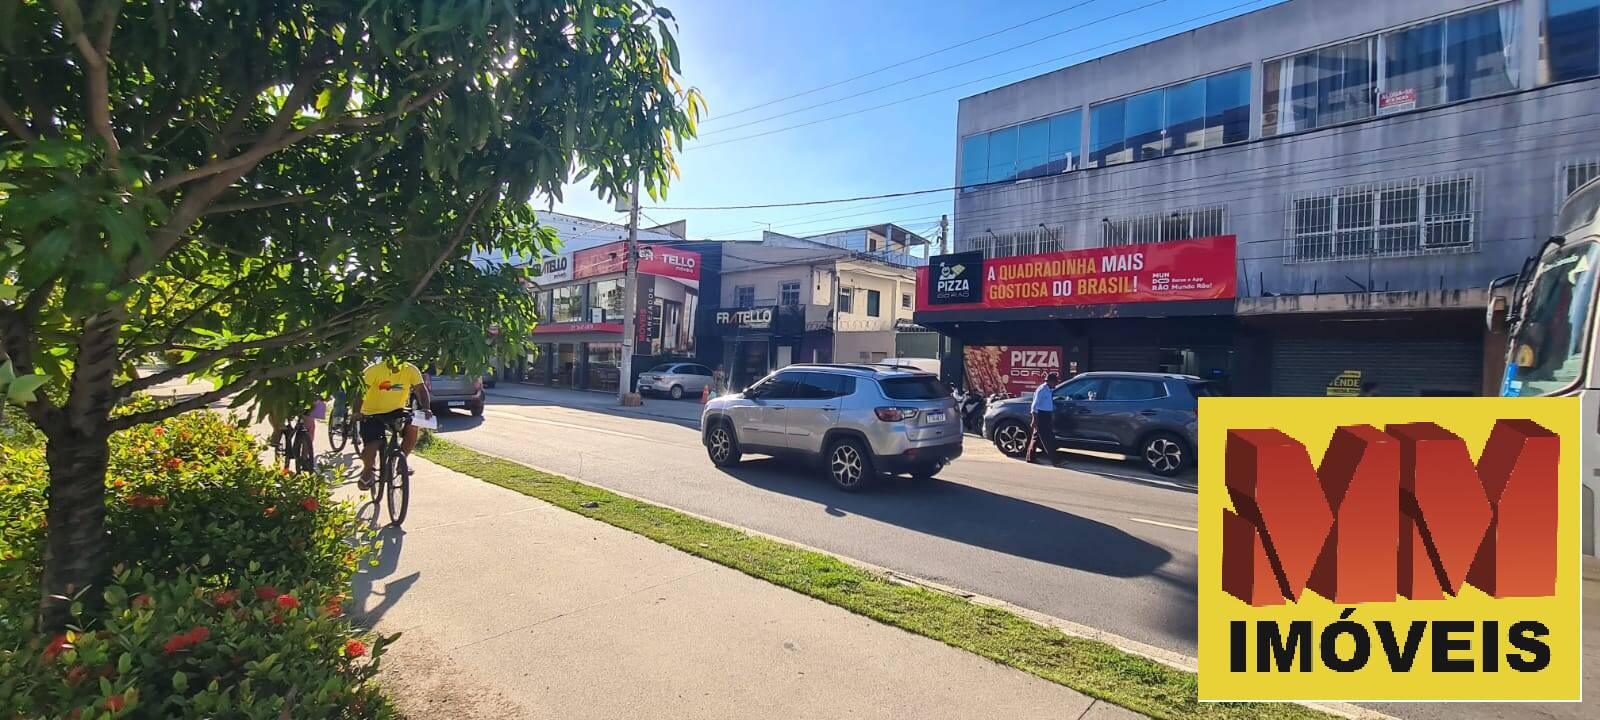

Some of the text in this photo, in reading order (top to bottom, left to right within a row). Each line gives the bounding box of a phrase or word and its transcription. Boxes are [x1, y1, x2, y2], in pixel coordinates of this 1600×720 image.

[987, 253, 1144, 281] A QUADRADINHA MAIS
[937, 279, 970, 292] PIZZA
[989, 275, 1138, 300] GOSTOSA DO BRASIL!
[716, 309, 772, 324] FRATELLO
[1011, 350, 1060, 368] PIZZA
